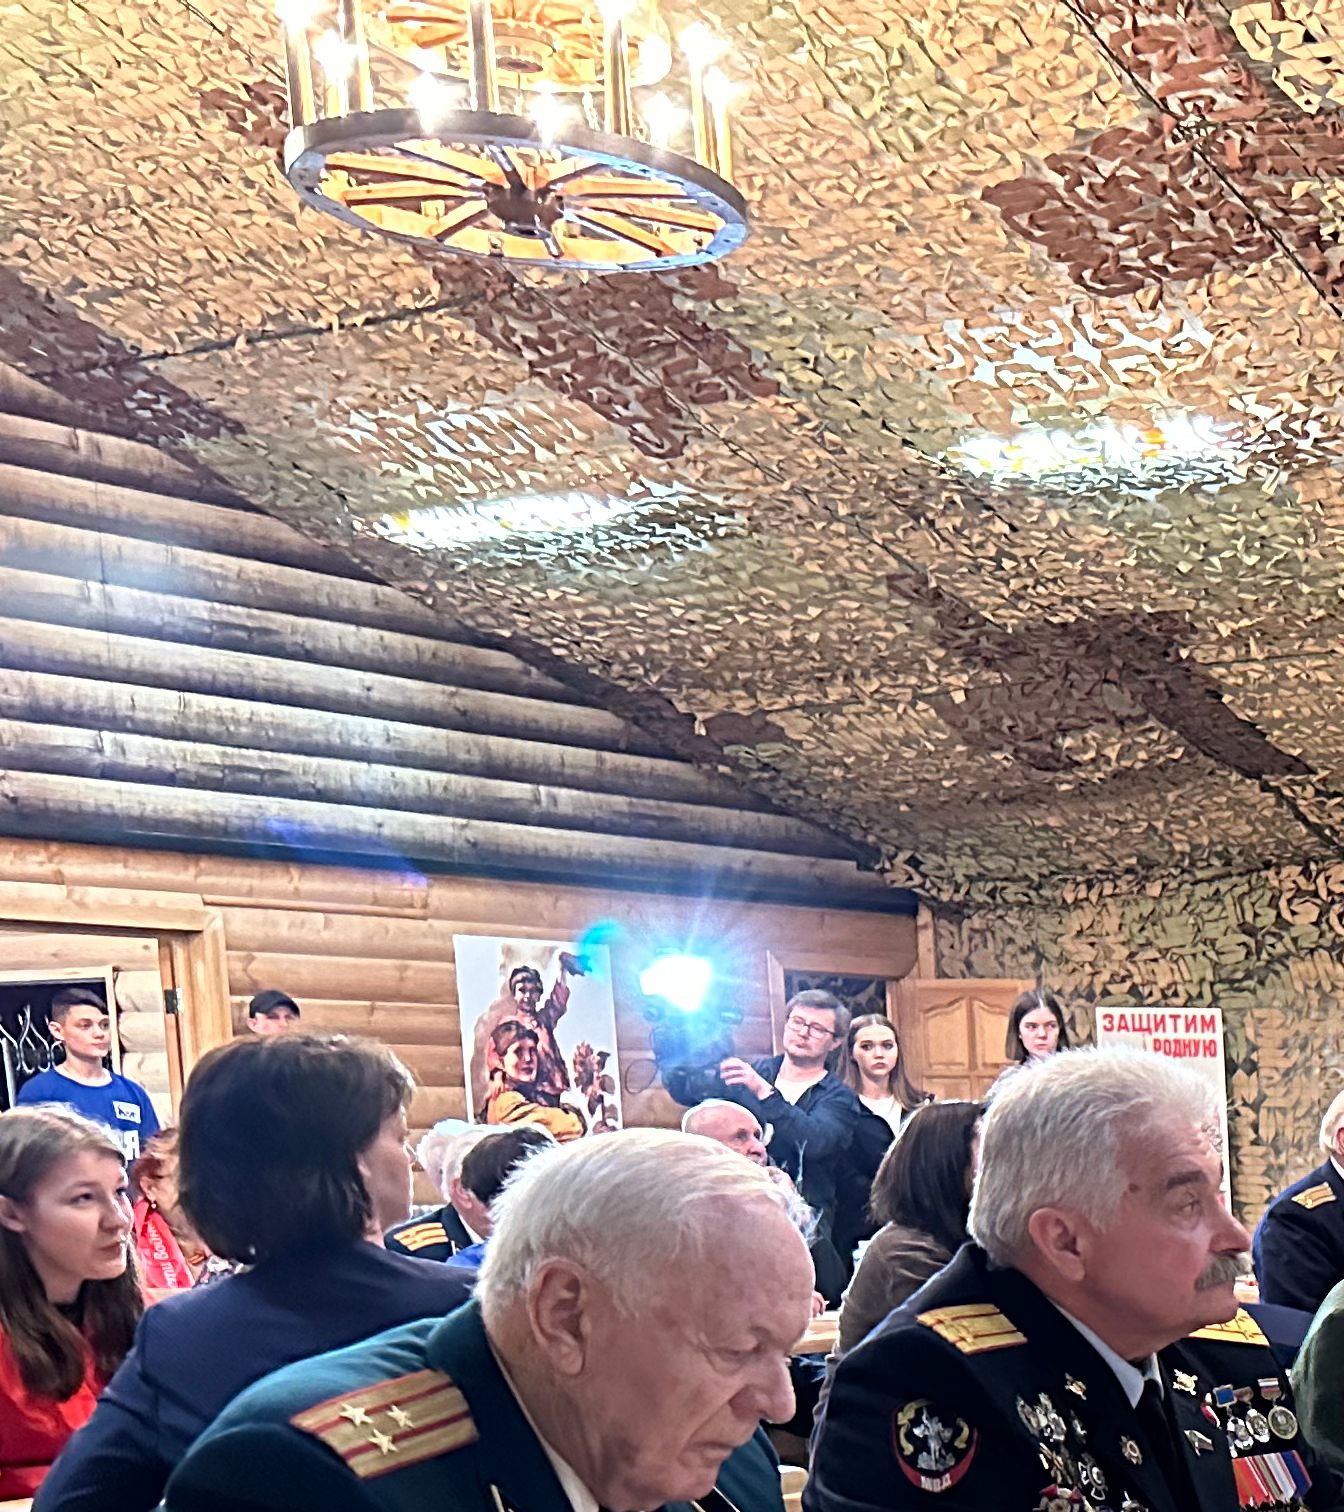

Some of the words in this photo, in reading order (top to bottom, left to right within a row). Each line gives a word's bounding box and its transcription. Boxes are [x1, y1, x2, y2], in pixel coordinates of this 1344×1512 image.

[1102, 1013, 1217, 1035] ЗАЩИТИМ
[1153, 1038, 1218, 1058] РОДНУЮ
[920, 1473, 952, 1493] МВД
